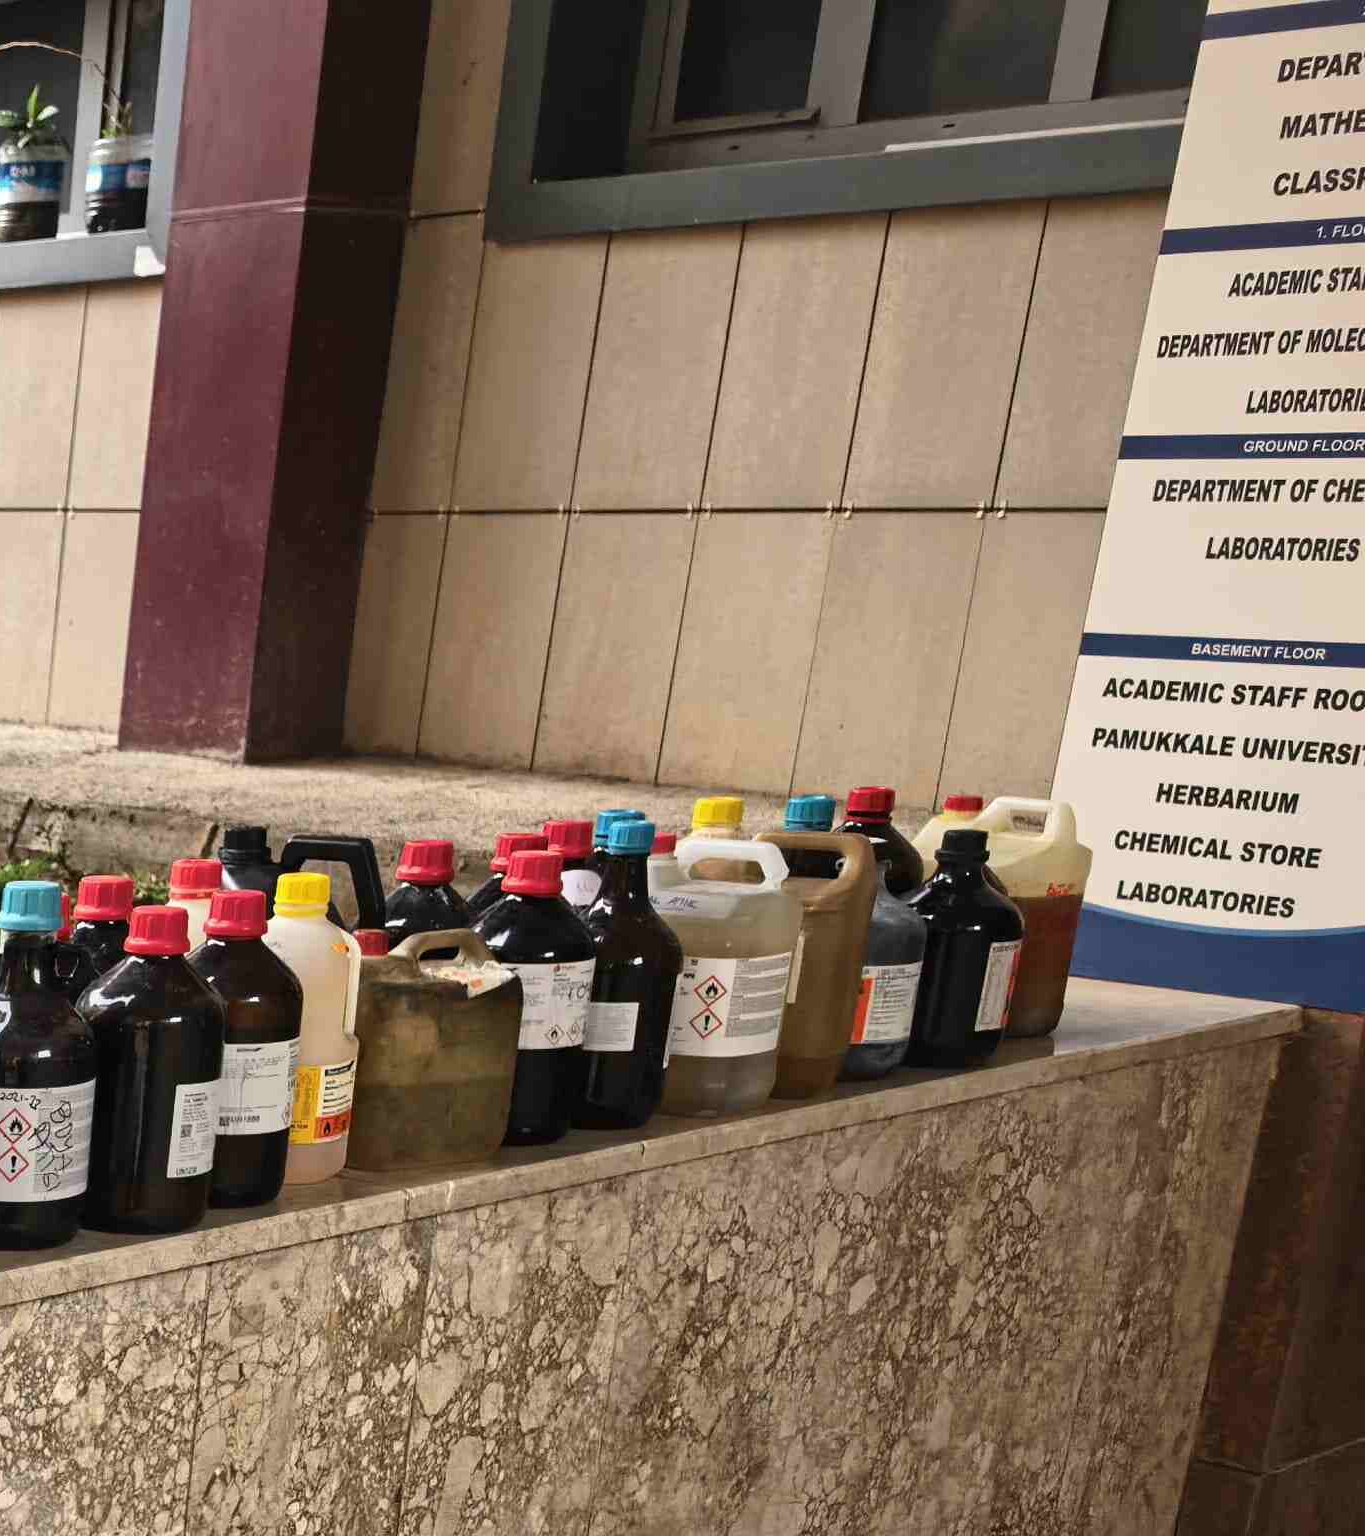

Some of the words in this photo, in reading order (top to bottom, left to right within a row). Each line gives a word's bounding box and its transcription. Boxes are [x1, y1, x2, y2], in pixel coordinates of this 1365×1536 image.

[1277, 51, 1365, 83] DEPAR
[1316, 226, 1327, 239] 1.
[1228, 268, 1323, 298] ACADEMIC
[1156, 331, 1275, 359] DEPARTMENT
[1277, 330, 1303, 354] OF
[1244, 440, 1308, 453] GROUND
[1312, 439, 1365, 451] FLOOR
[1152, 478, 1286, 503] DEPARTMENT
[1289, 478, 1318, 503] OF
[1204, 536, 1362, 563] LABORATORIES
[1191, 642, 1271, 659] BASEMENT
[1274, 646, 1326, 661] FLOOR
[1102, 677, 1225, 705] ACADEMIC
[1230, 683, 1308, 709] STAFF
[1091, 727, 1236, 757] PAMUKKALE
[1155, 782, 1300, 815] HERBARIUM
[1114, 829, 1233, 861] CHEMICAL
[1239, 841, 1323, 870] STORE
[1116, 879, 1296, 919] LABORATORIES
